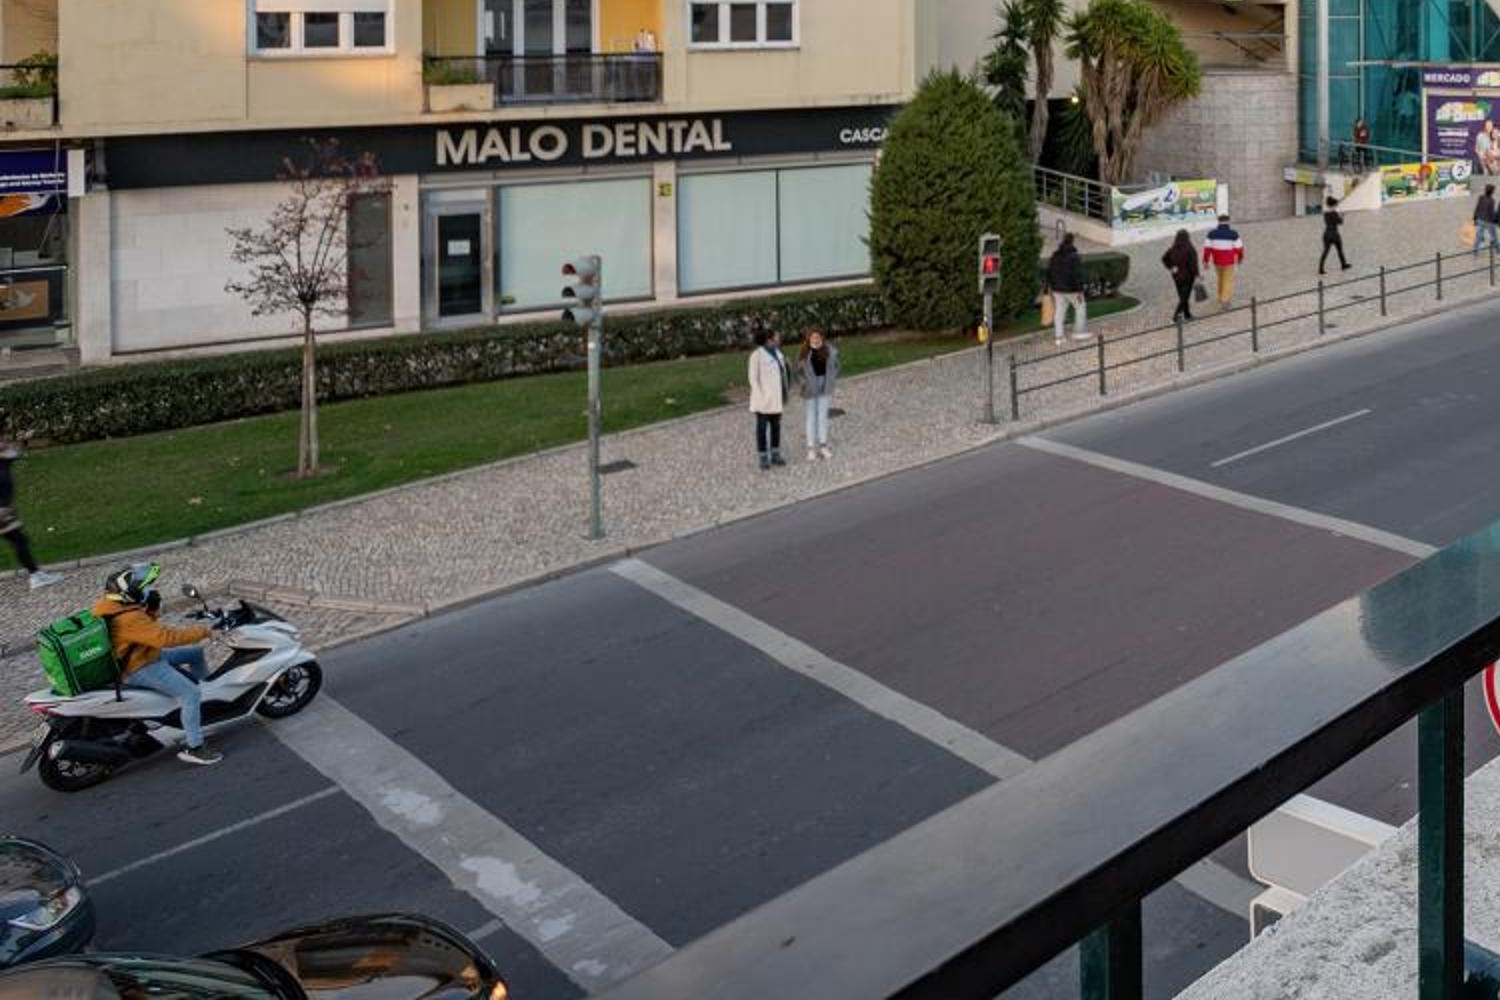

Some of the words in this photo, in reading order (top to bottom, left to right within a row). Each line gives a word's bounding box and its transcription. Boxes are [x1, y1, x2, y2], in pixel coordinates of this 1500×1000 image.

[1424, 73, 1471, 84] MERCADO
[436, 125, 568, 166] MALO
[581, 119, 732, 158] DENTAL
